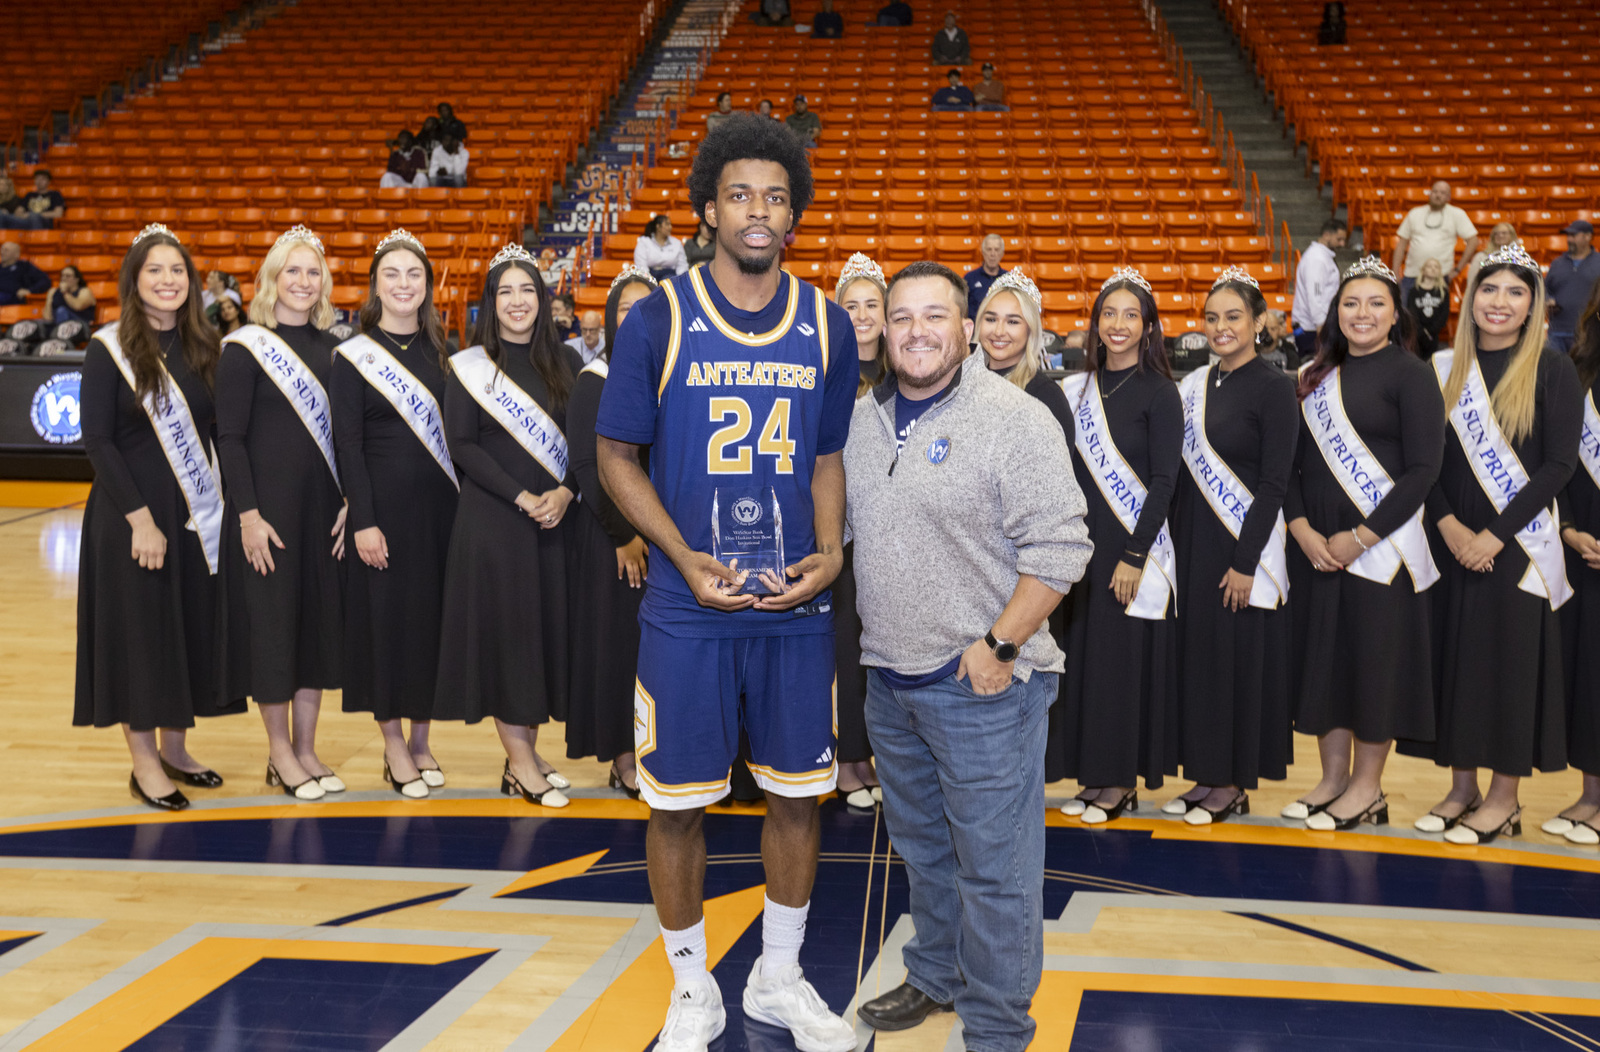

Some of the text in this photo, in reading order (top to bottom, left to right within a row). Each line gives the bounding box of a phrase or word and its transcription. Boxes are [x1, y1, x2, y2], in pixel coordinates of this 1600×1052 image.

[265, 347, 295, 378] 2025
[292, 378, 320, 412] SUN
[377, 365, 410, 394] 2025
[406, 394, 434, 427] SUN
[686, 361, 817, 390] ANTEATERS
[496, 391, 525, 420] 2025
[520, 416, 552, 447] SUN
[707, 397, 796, 475] 24
[1078, 400, 1096, 432] 2025
[1315, 401, 1336, 433] SUN
[1463, 409, 1489, 447] SUN
[168, 419, 207, 496] PRINCESS
[1085, 432, 1111, 470] SUN
